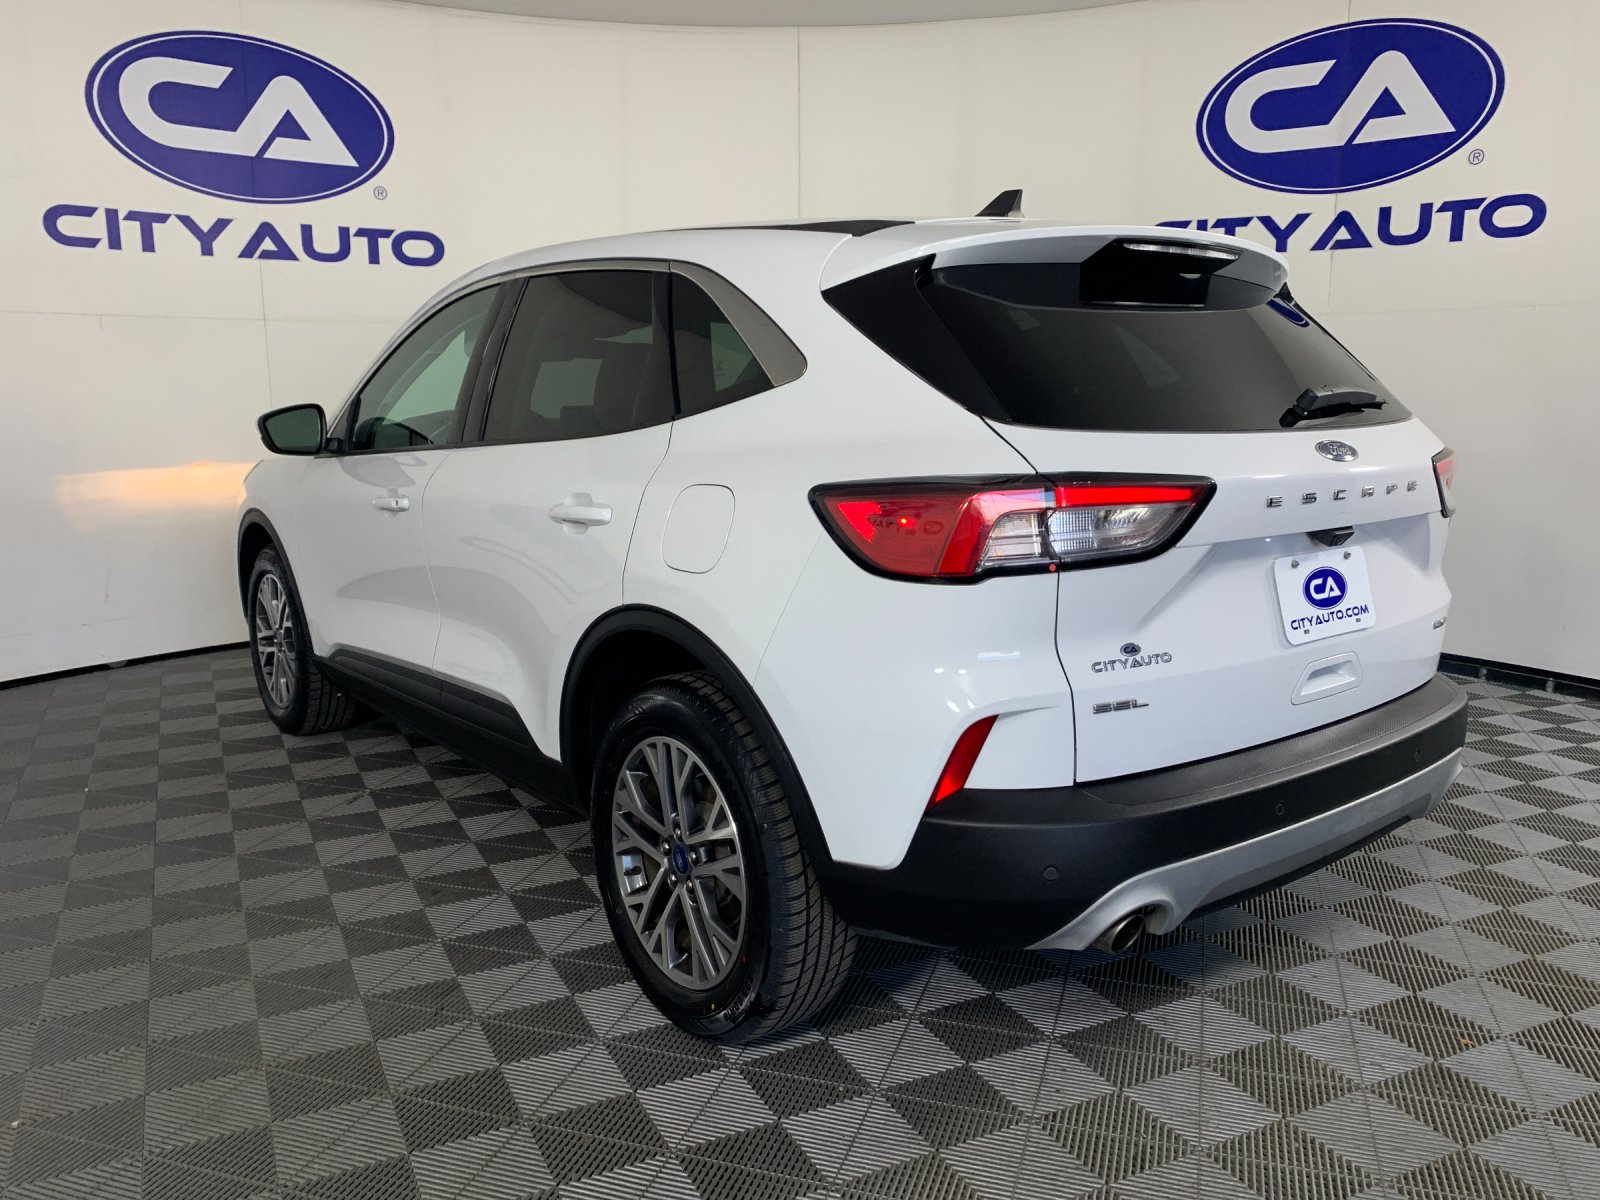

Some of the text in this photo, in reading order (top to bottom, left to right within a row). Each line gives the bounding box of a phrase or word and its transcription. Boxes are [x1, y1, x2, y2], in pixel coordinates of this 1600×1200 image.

[119, 56, 359, 167] CA
[1225, 50, 1456, 153] CA
[1266, 480, 1418, 508] ESCAPE
[1309, 576, 1342, 601] CA
[1290, 604, 1370, 630] CITYAUTO.COM
[1093, 698, 1150, 715] SEL
